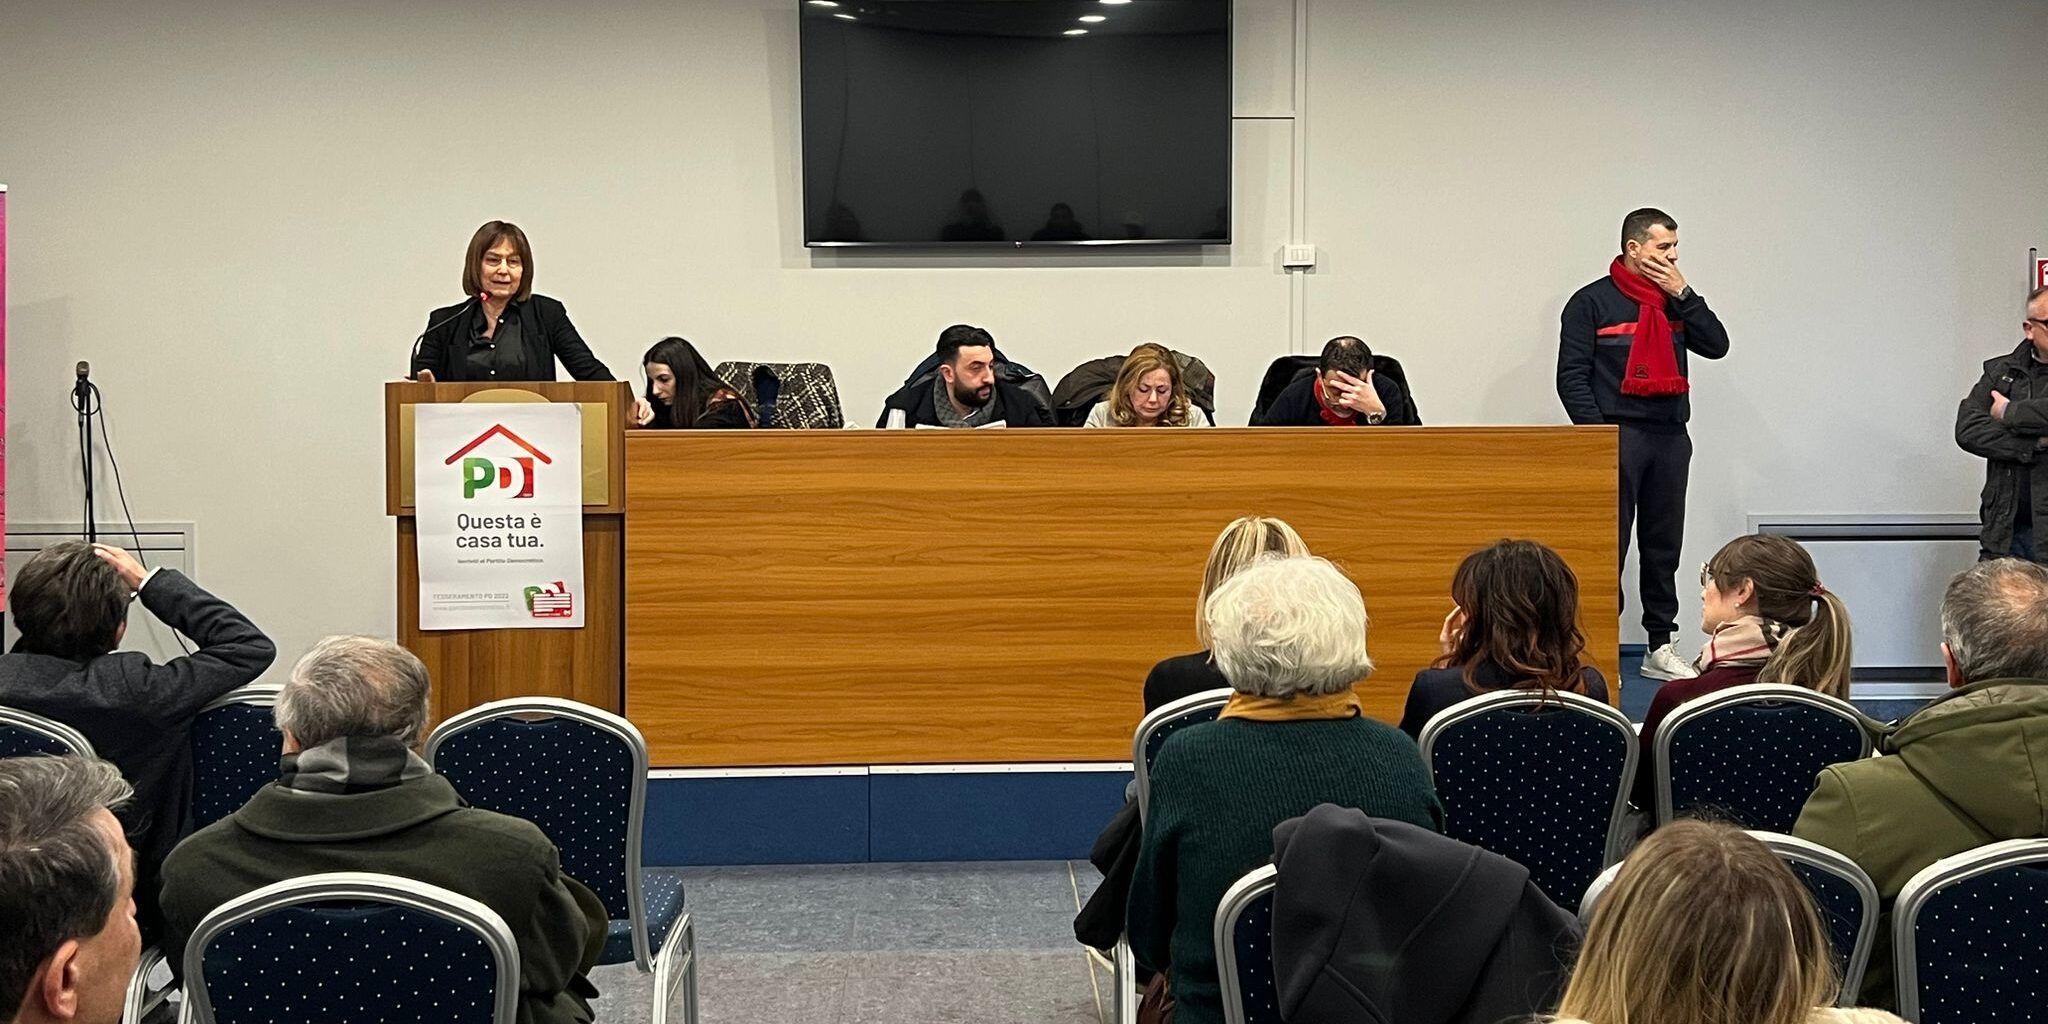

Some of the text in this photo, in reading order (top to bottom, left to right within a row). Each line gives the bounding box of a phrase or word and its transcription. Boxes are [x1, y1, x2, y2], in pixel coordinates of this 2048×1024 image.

[463, 457, 534, 499] PD
[457, 513, 542, 531] Questa è
[456, 533, 544, 548] casa tua.
